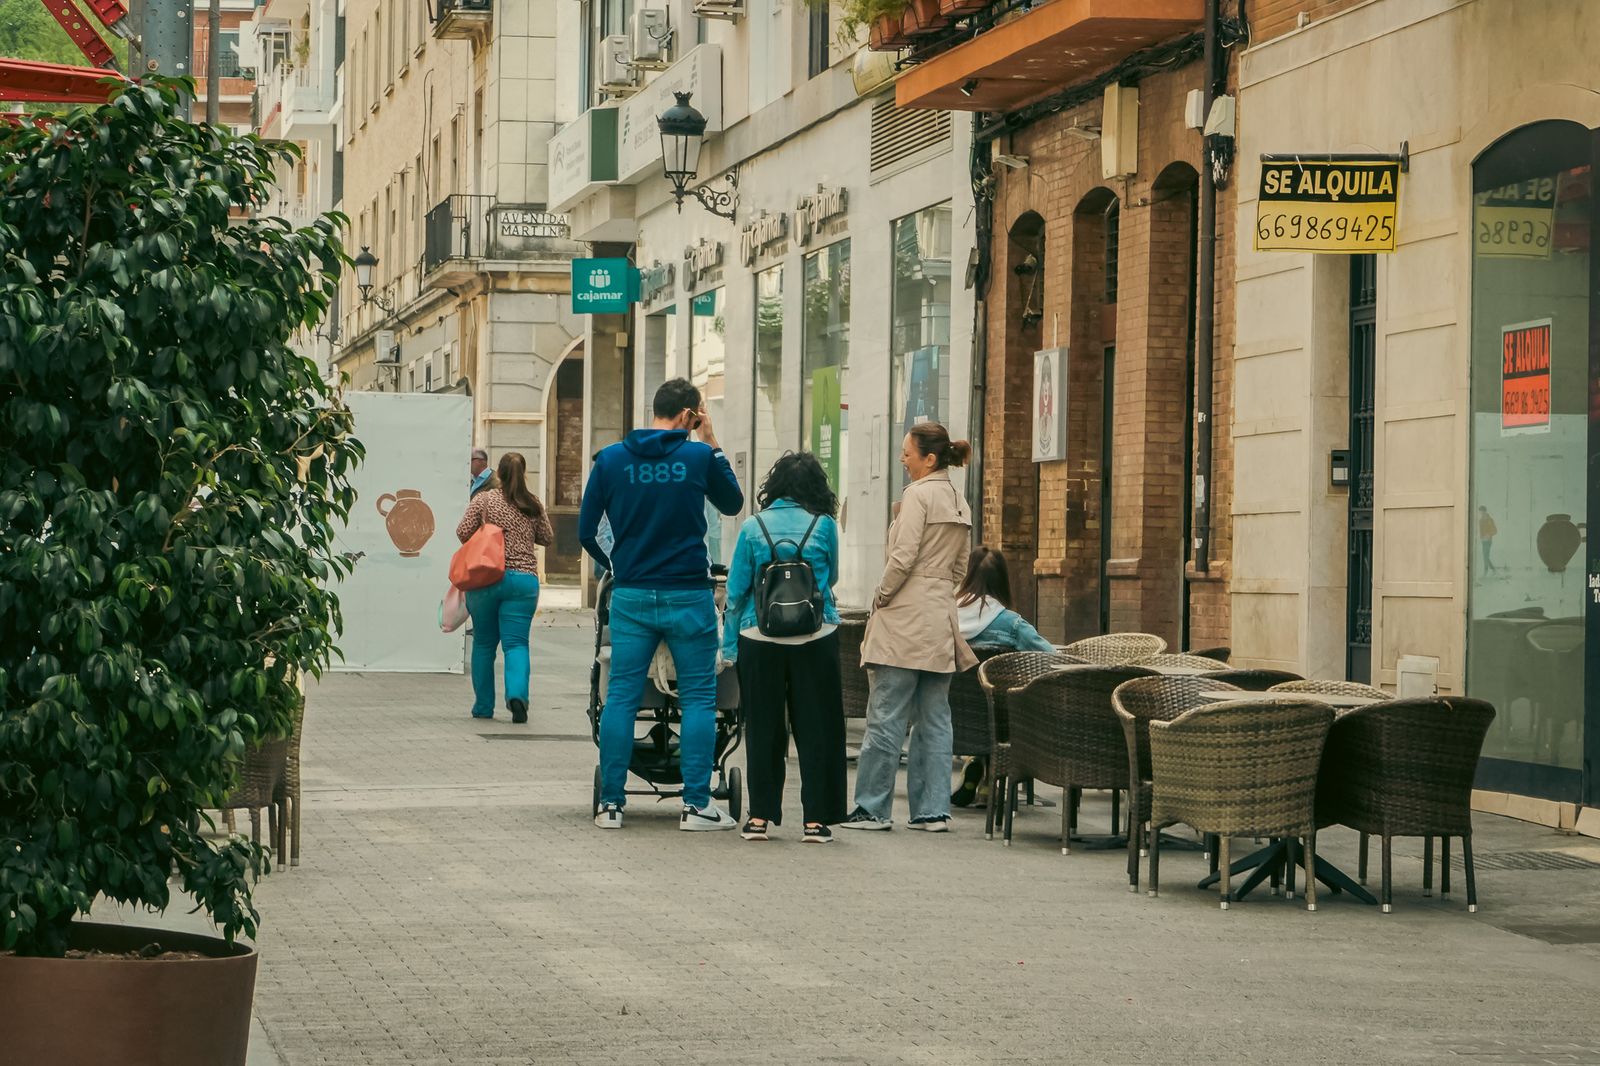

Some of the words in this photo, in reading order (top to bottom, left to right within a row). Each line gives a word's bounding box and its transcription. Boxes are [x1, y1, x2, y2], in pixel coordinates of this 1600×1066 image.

[1265, 170, 1293, 194] SE
[1298, 170, 1394, 201] ALQUILA
[502, 213, 566, 224] AVENIDA
[1258, 214, 1393, 241] 669869425
[577, 290, 623, 303] cajamar
[1504, 332, 1513, 374] SE
[1515, 326, 1550, 373] ALQUILA
[623, 462, 687, 484] 1889
